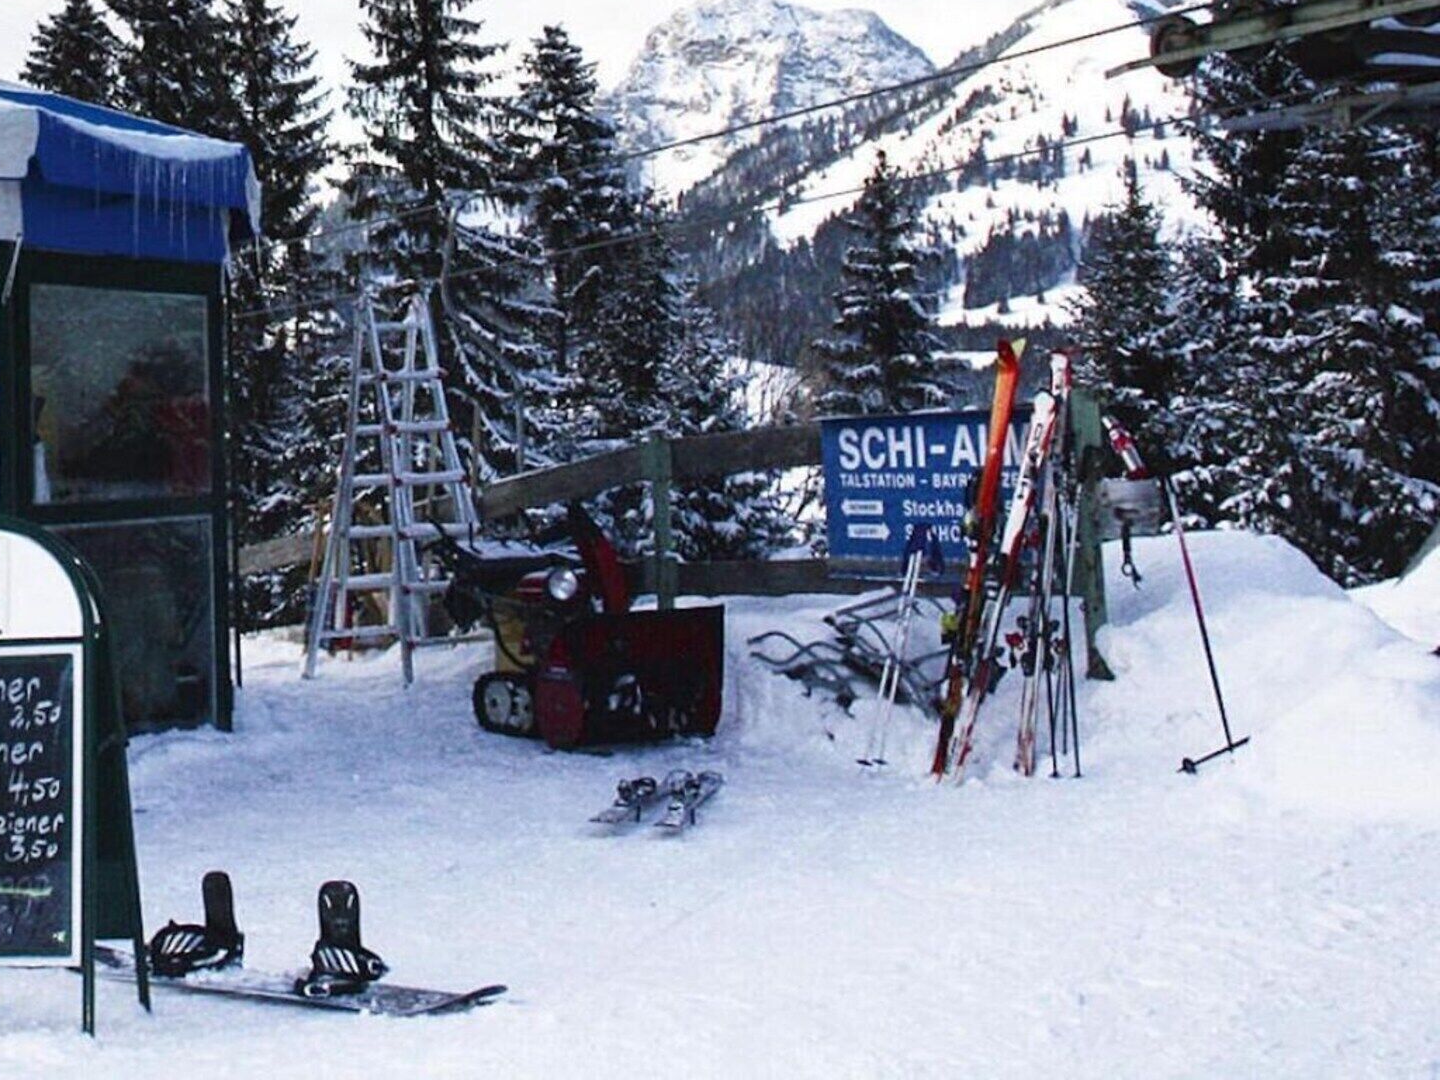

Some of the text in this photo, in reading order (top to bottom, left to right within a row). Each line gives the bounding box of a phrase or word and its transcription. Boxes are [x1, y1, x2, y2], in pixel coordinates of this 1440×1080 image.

[840, 473, 916, 489] TALSTATION
[10, 700, 61, 731] 2,50
[8, 770, 61, 807] 4,50
[4, 835, 59, 864] 3,50
